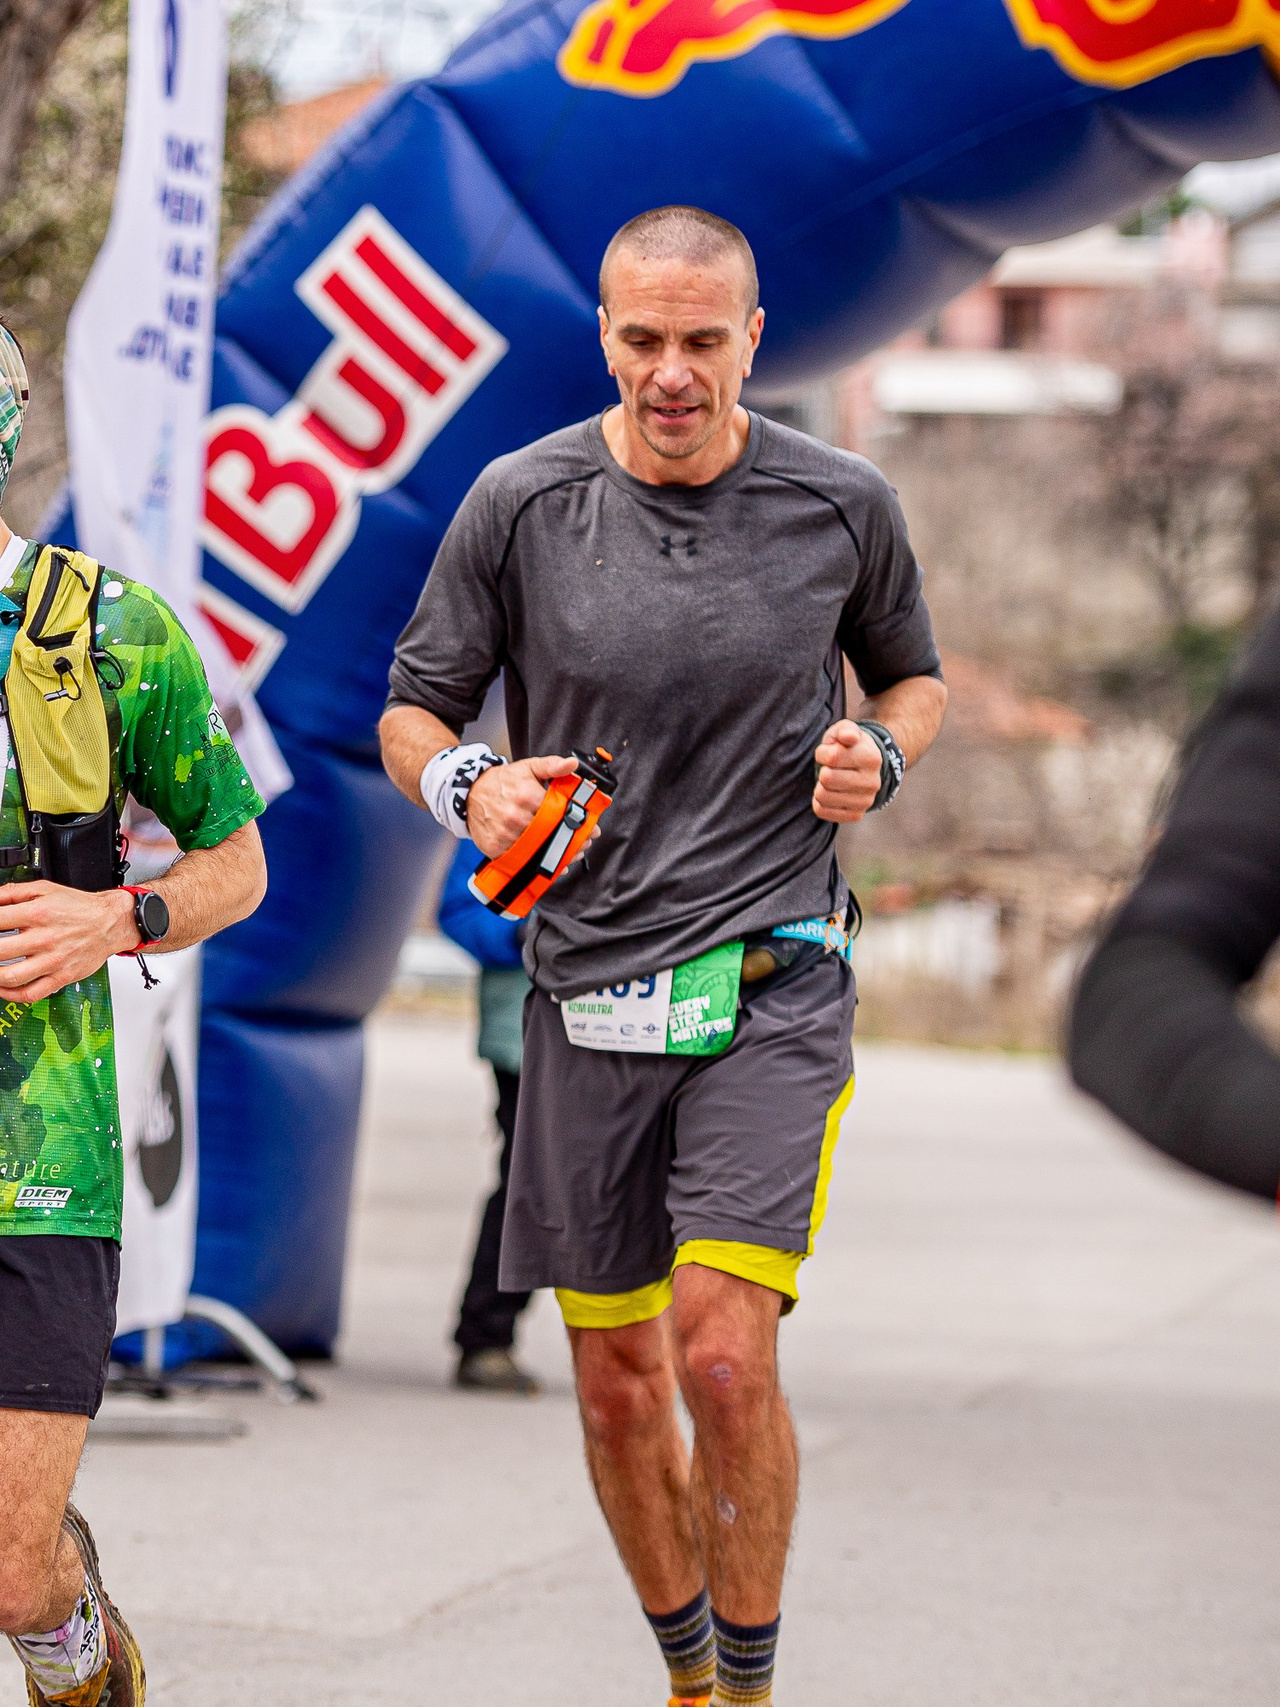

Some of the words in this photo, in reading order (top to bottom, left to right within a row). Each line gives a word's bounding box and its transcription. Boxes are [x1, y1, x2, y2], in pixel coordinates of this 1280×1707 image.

[202, 222, 496, 598] Bull
[669, 1011, 704, 1031] STEP
[21, 1188, 69, 1199] DIEM
